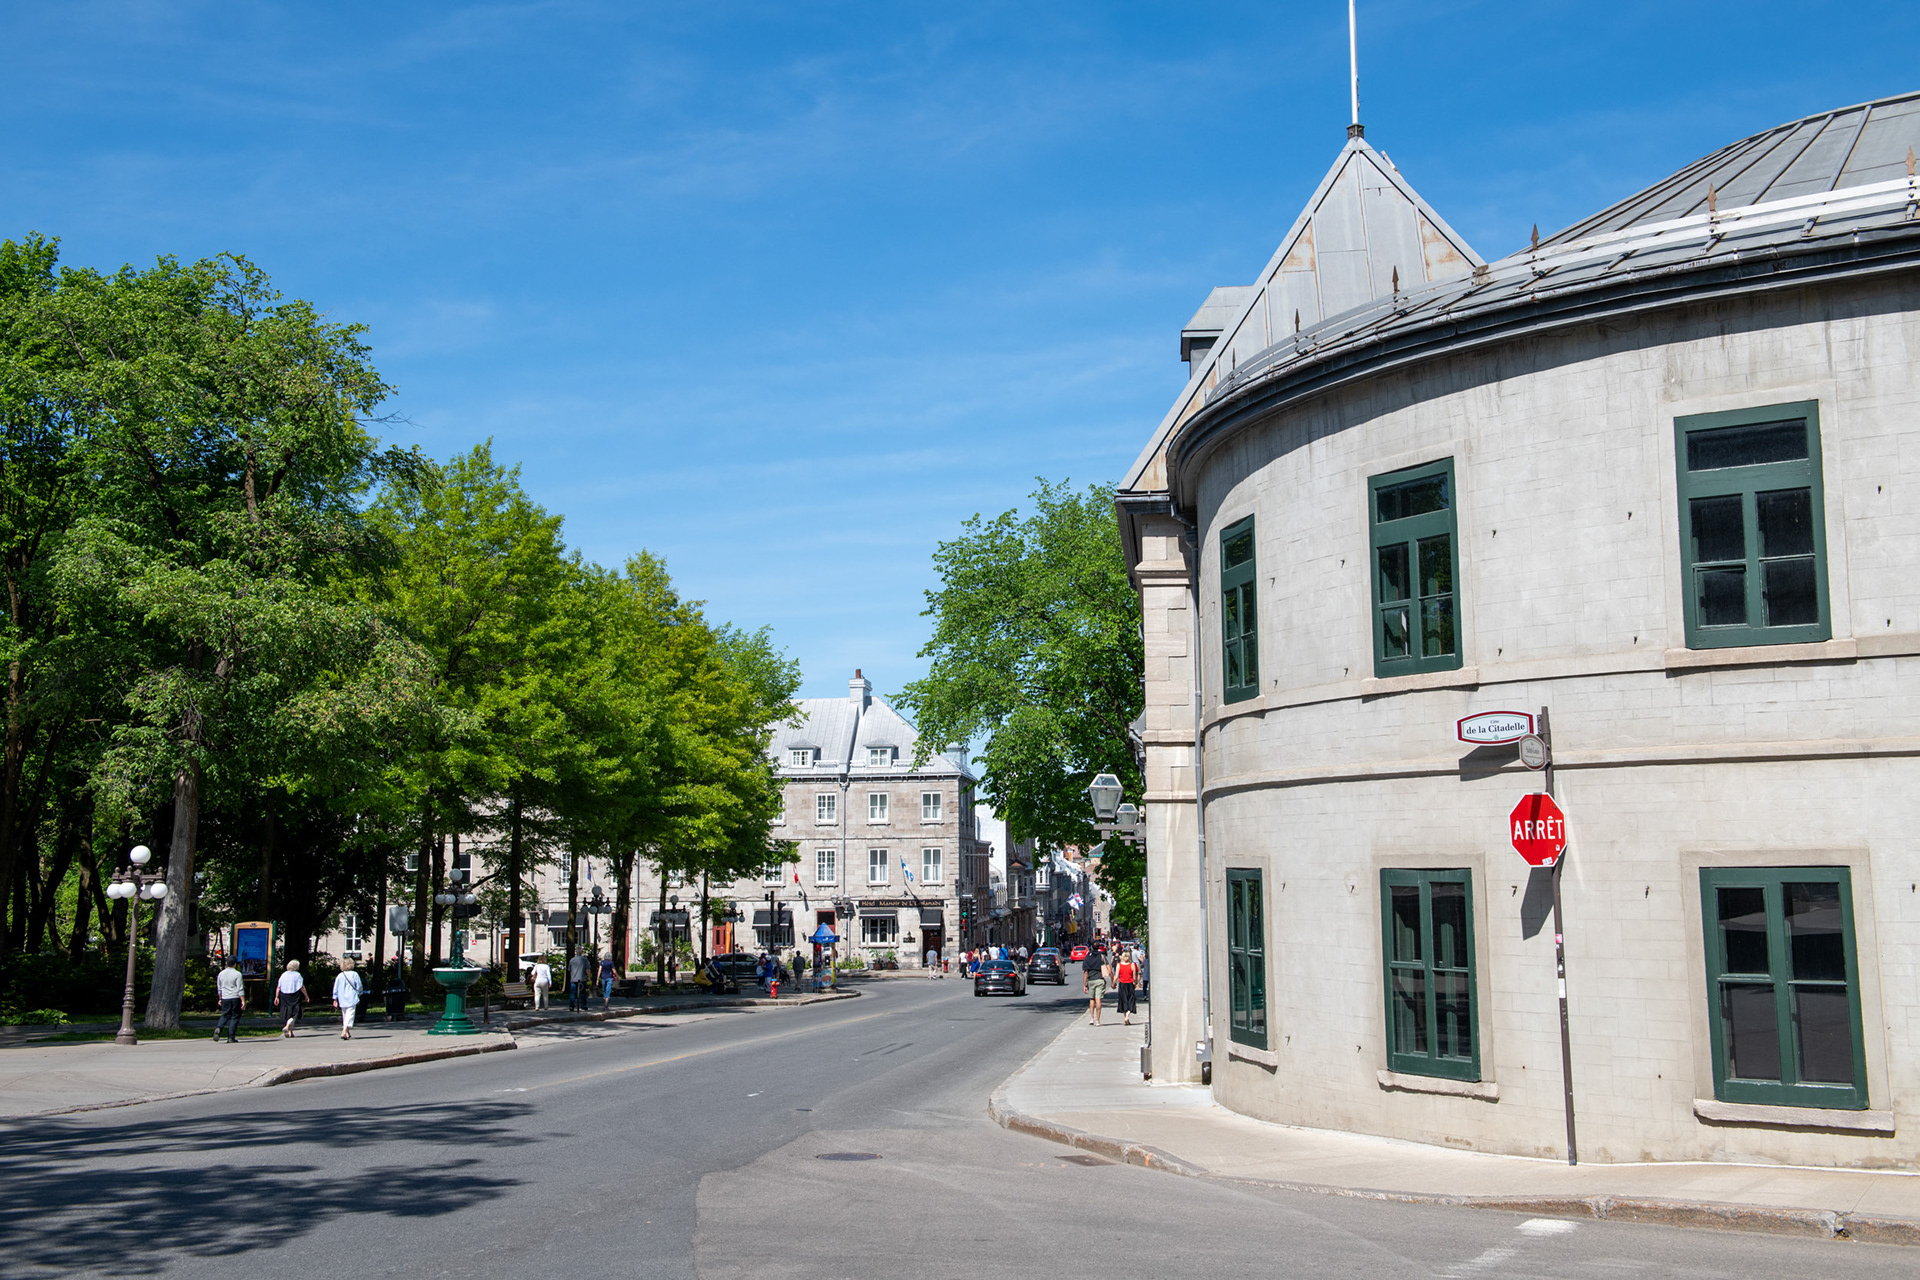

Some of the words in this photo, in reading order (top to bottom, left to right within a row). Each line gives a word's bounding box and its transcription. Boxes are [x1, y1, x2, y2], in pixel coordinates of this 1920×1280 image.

[1466, 726, 1477, 734] de
[1478, 725, 1486, 734] la
[1488, 722, 1526, 732] Citadelle
[1514, 816, 1562, 840] ARRÊT
